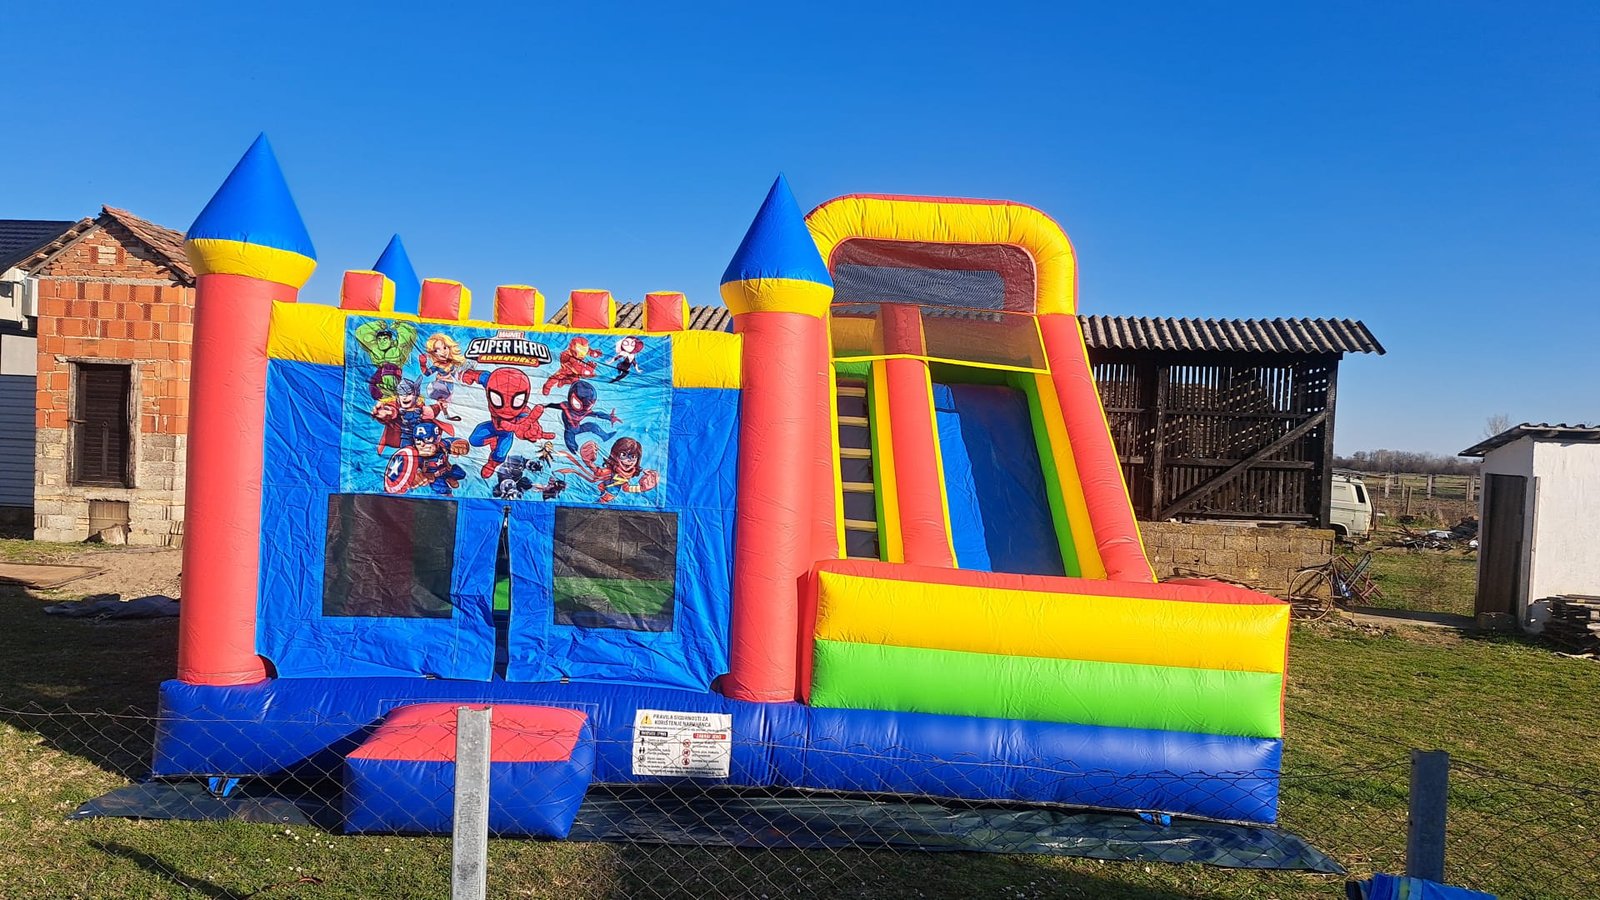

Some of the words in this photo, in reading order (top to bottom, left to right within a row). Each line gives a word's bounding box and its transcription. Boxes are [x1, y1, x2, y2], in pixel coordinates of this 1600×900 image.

[469, 340, 511, 354] SUPER
[513, 340, 547, 358] HERO
[480, 355, 537, 365] ADVENTURES
